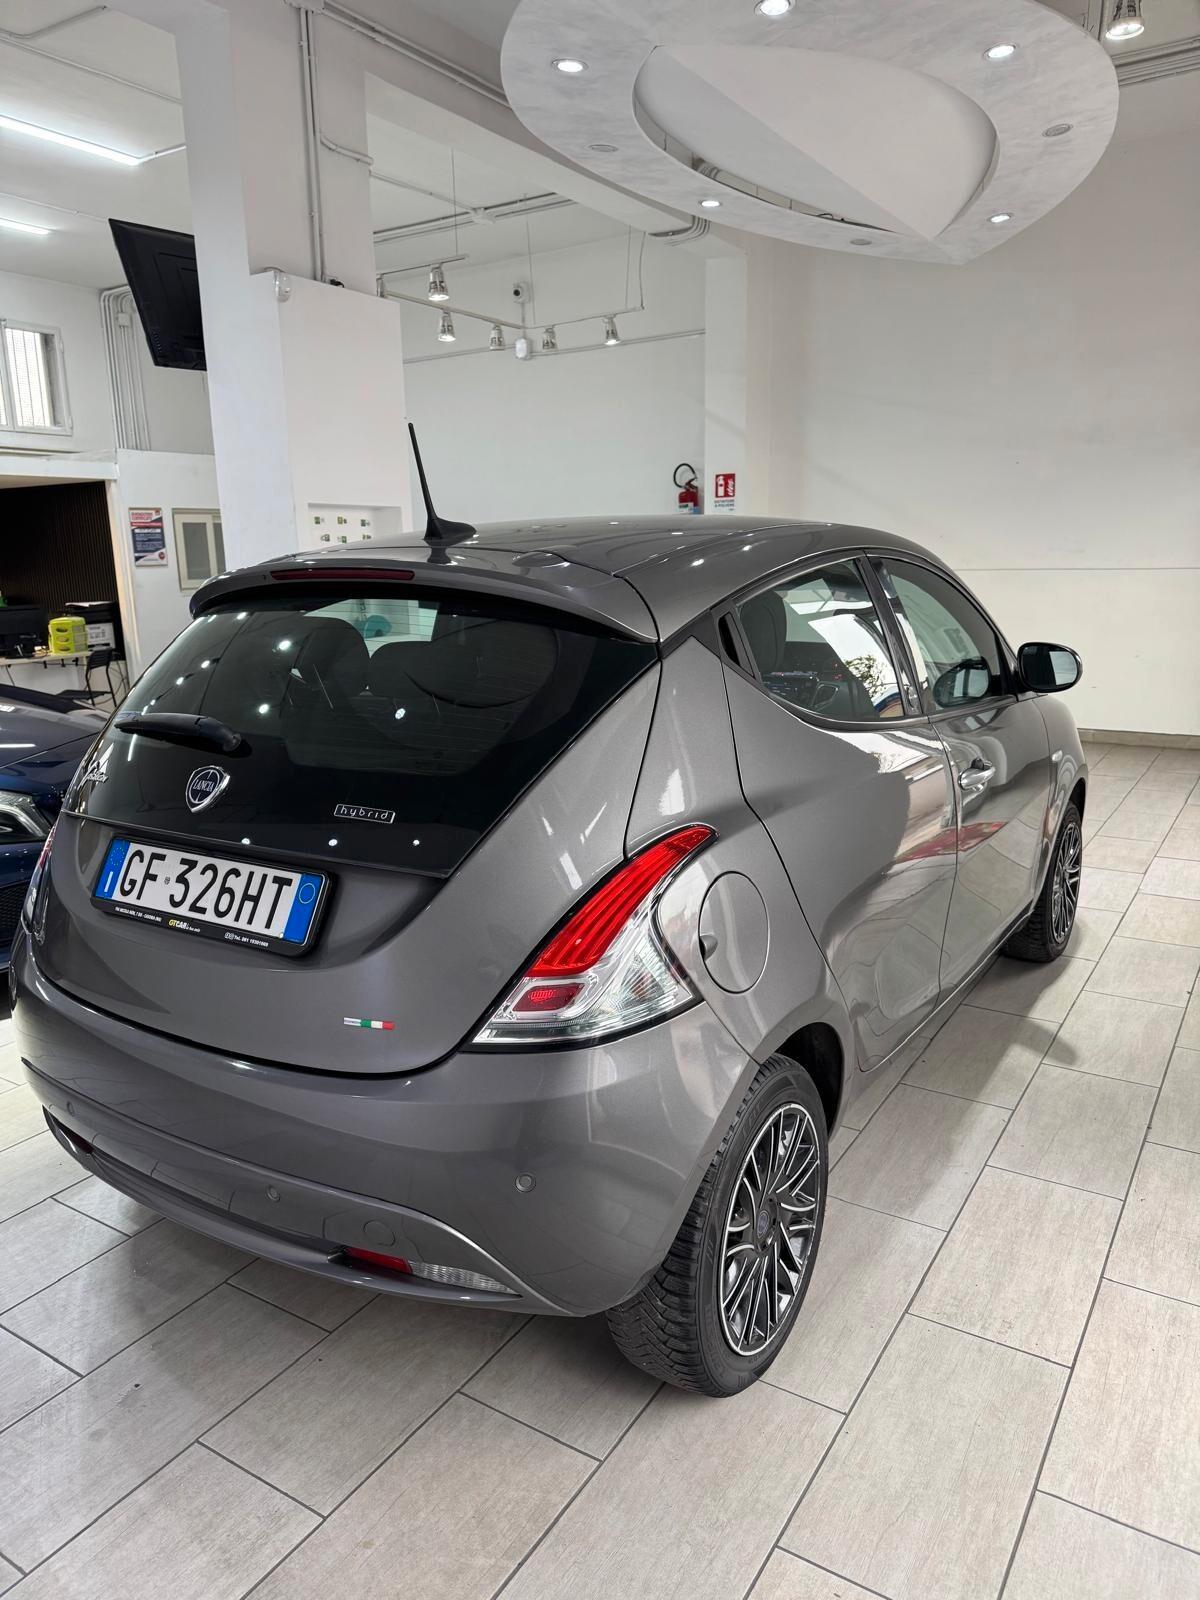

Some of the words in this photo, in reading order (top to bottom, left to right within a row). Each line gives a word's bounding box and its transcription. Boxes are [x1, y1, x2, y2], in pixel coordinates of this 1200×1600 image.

[193, 779, 215, 792] LANCIA
[340, 805, 389, 820] hybrid
[119, 849, 167, 901] GF
[169, 857, 294, 930] 326HT
